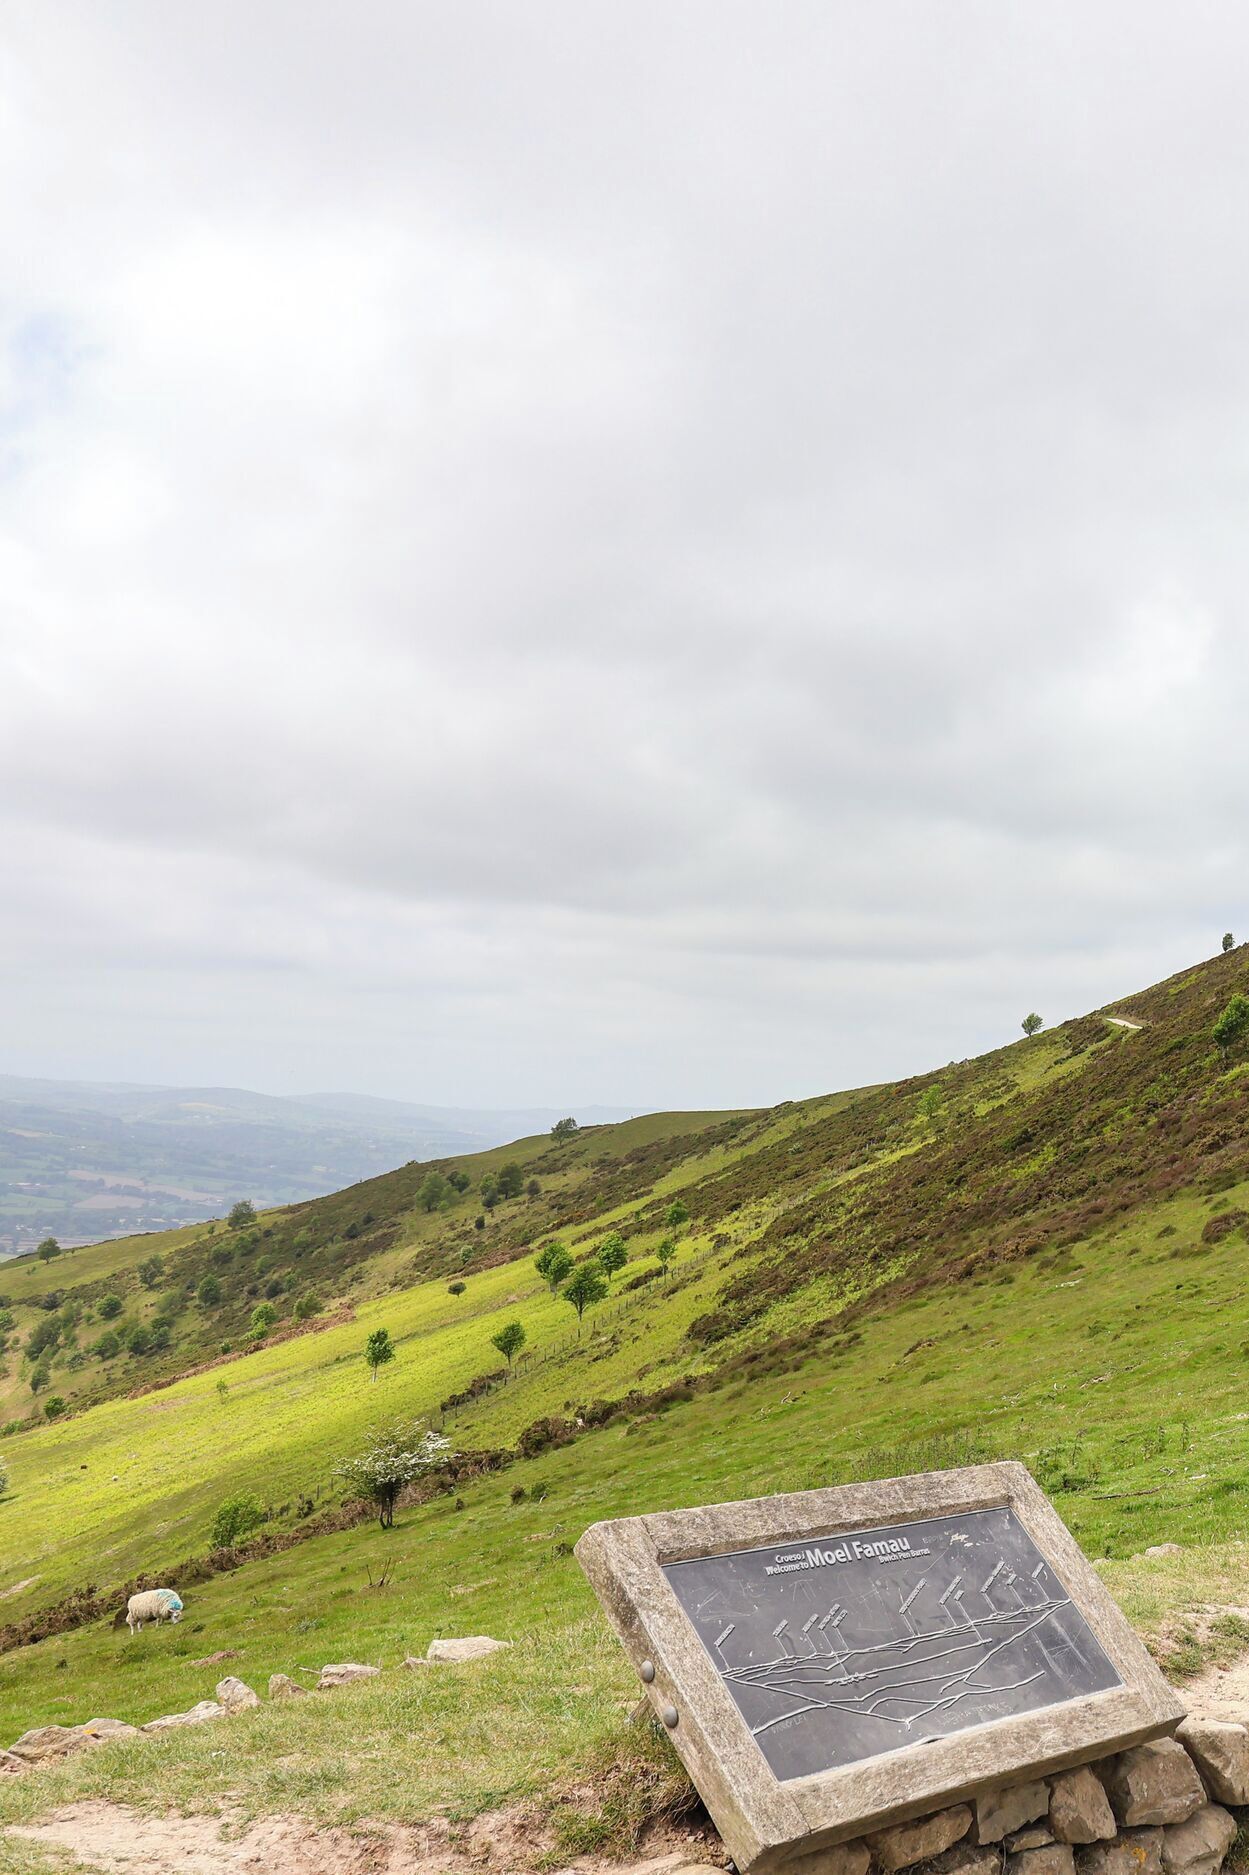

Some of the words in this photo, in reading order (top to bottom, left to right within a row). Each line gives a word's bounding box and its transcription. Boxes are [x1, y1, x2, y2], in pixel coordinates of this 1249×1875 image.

[775, 1552, 803, 1564] Croeso
[806, 1543, 853, 1568] Moel
[852, 1537, 911, 1560] Famau
[765, 1563, 803, 1575] Welcome
[802, 1561, 810, 1571] to
